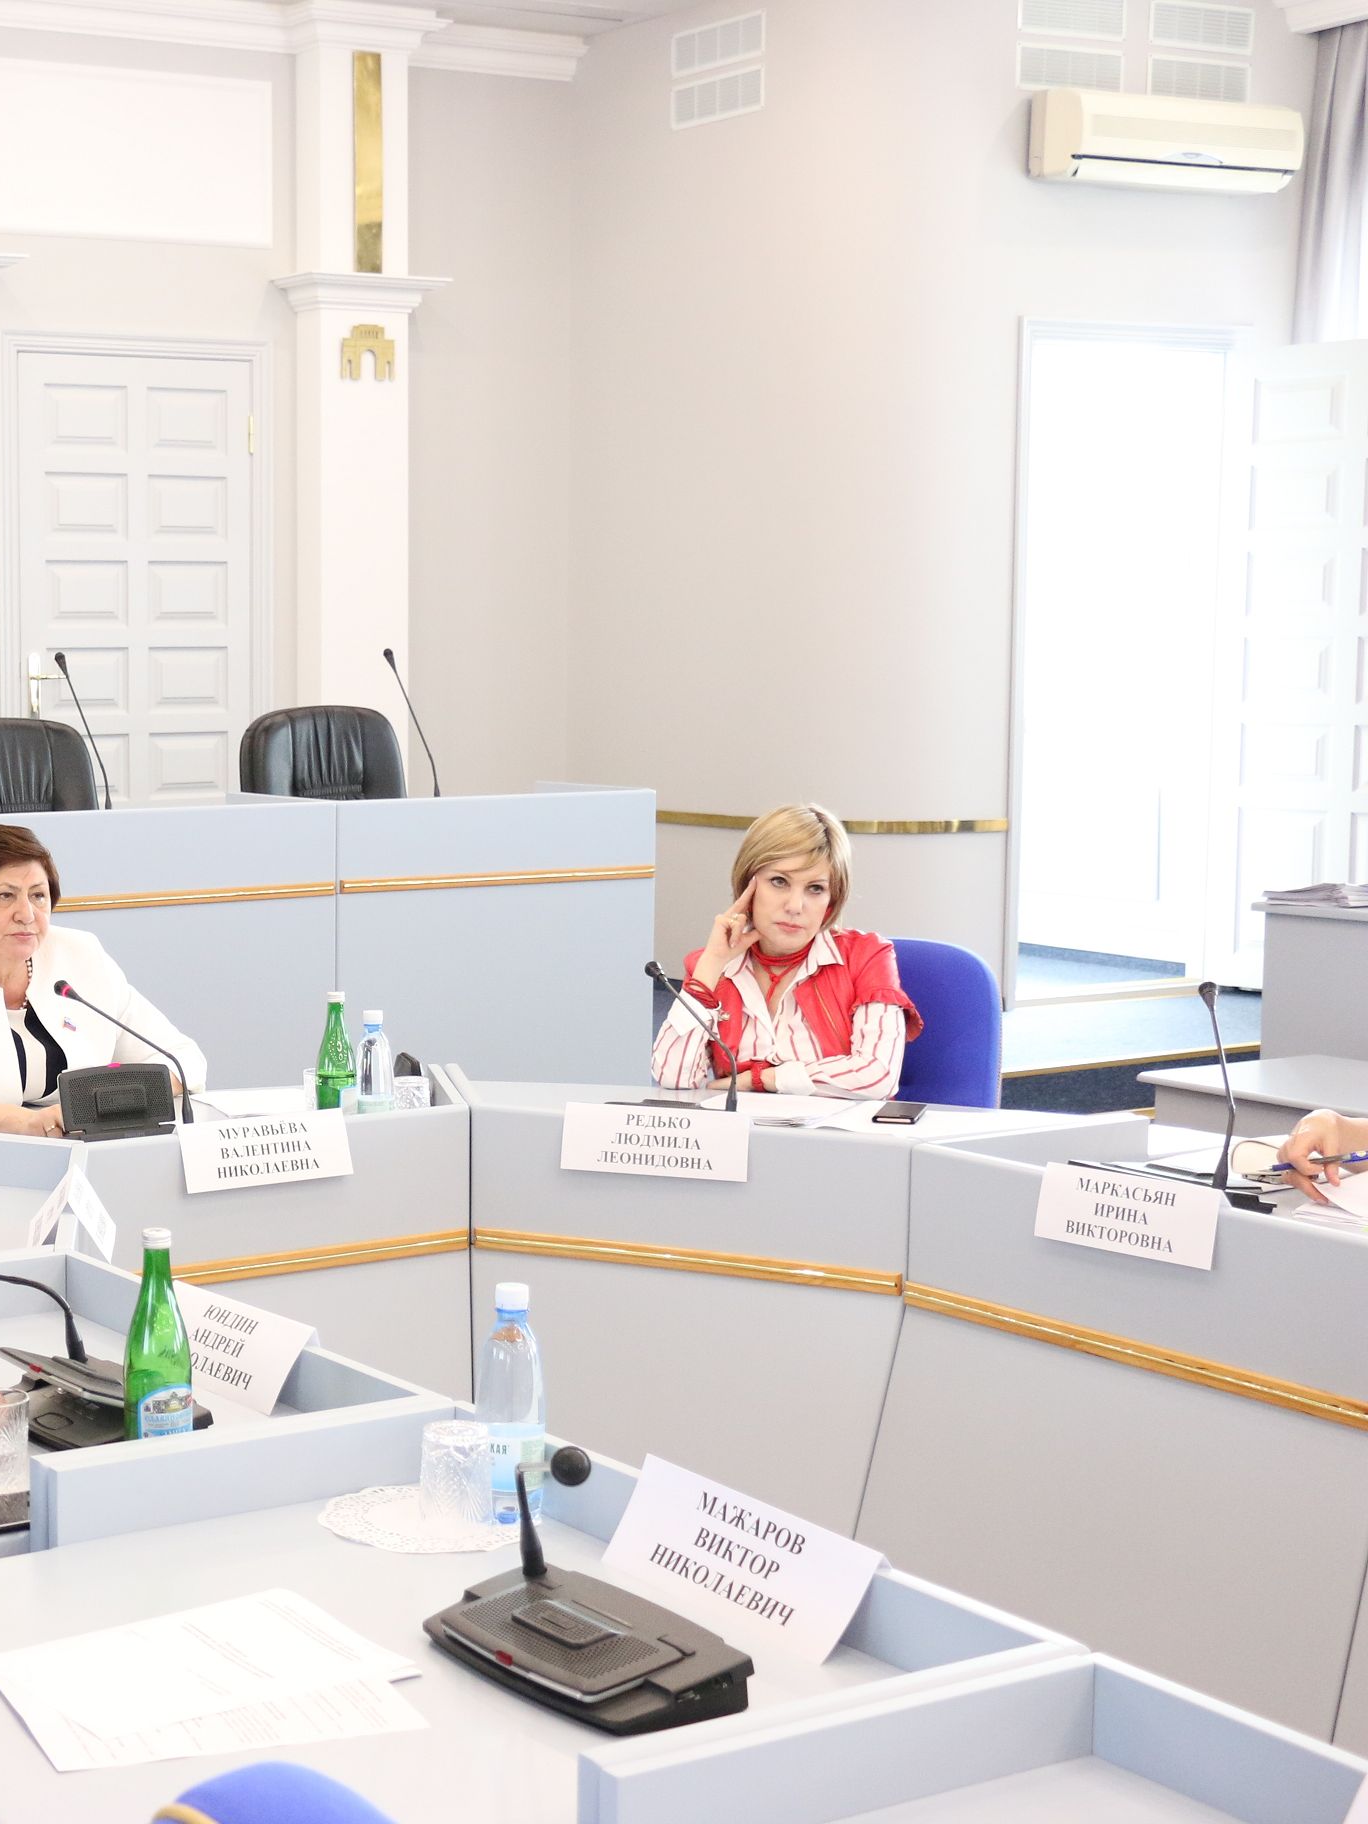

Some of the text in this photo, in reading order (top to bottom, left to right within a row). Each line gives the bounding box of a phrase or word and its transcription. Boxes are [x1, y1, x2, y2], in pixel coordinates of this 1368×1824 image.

[218, 1120, 307, 1141] МУРАВЬЁВА
[626, 1114, 691, 1130] РЕДЬКО
[221, 1140, 312, 1160] ВАЛЕНТИНА
[611, 1132, 701, 1150] ЛЮДМИЛА
[217, 1158, 320, 1179] НИКОЛАЕВНА
[597, 1151, 713, 1171] ЛЕОНИДОВНА
[1076, 1177, 1177, 1207] МАРКАСЬЯН
[1094, 1203, 1148, 1225] ИРИНА
[1066, 1220, 1173, 1253] ВИКТОРОВНА
[203, 1304, 259, 1335] ЮНДИН
[189, 1327, 246, 1358] АНДРЕЙ
[190, 1352, 253, 1391] ОЛАЕВИЧ
[490, 1443, 507, 1455] КАЯ
[696, 1491, 806, 1555] МАЖАРОВ
[694, 1527, 780, 1580] ВИКТОР
[648, 1543, 795, 1626] НИКОЛАЕВИЧ
